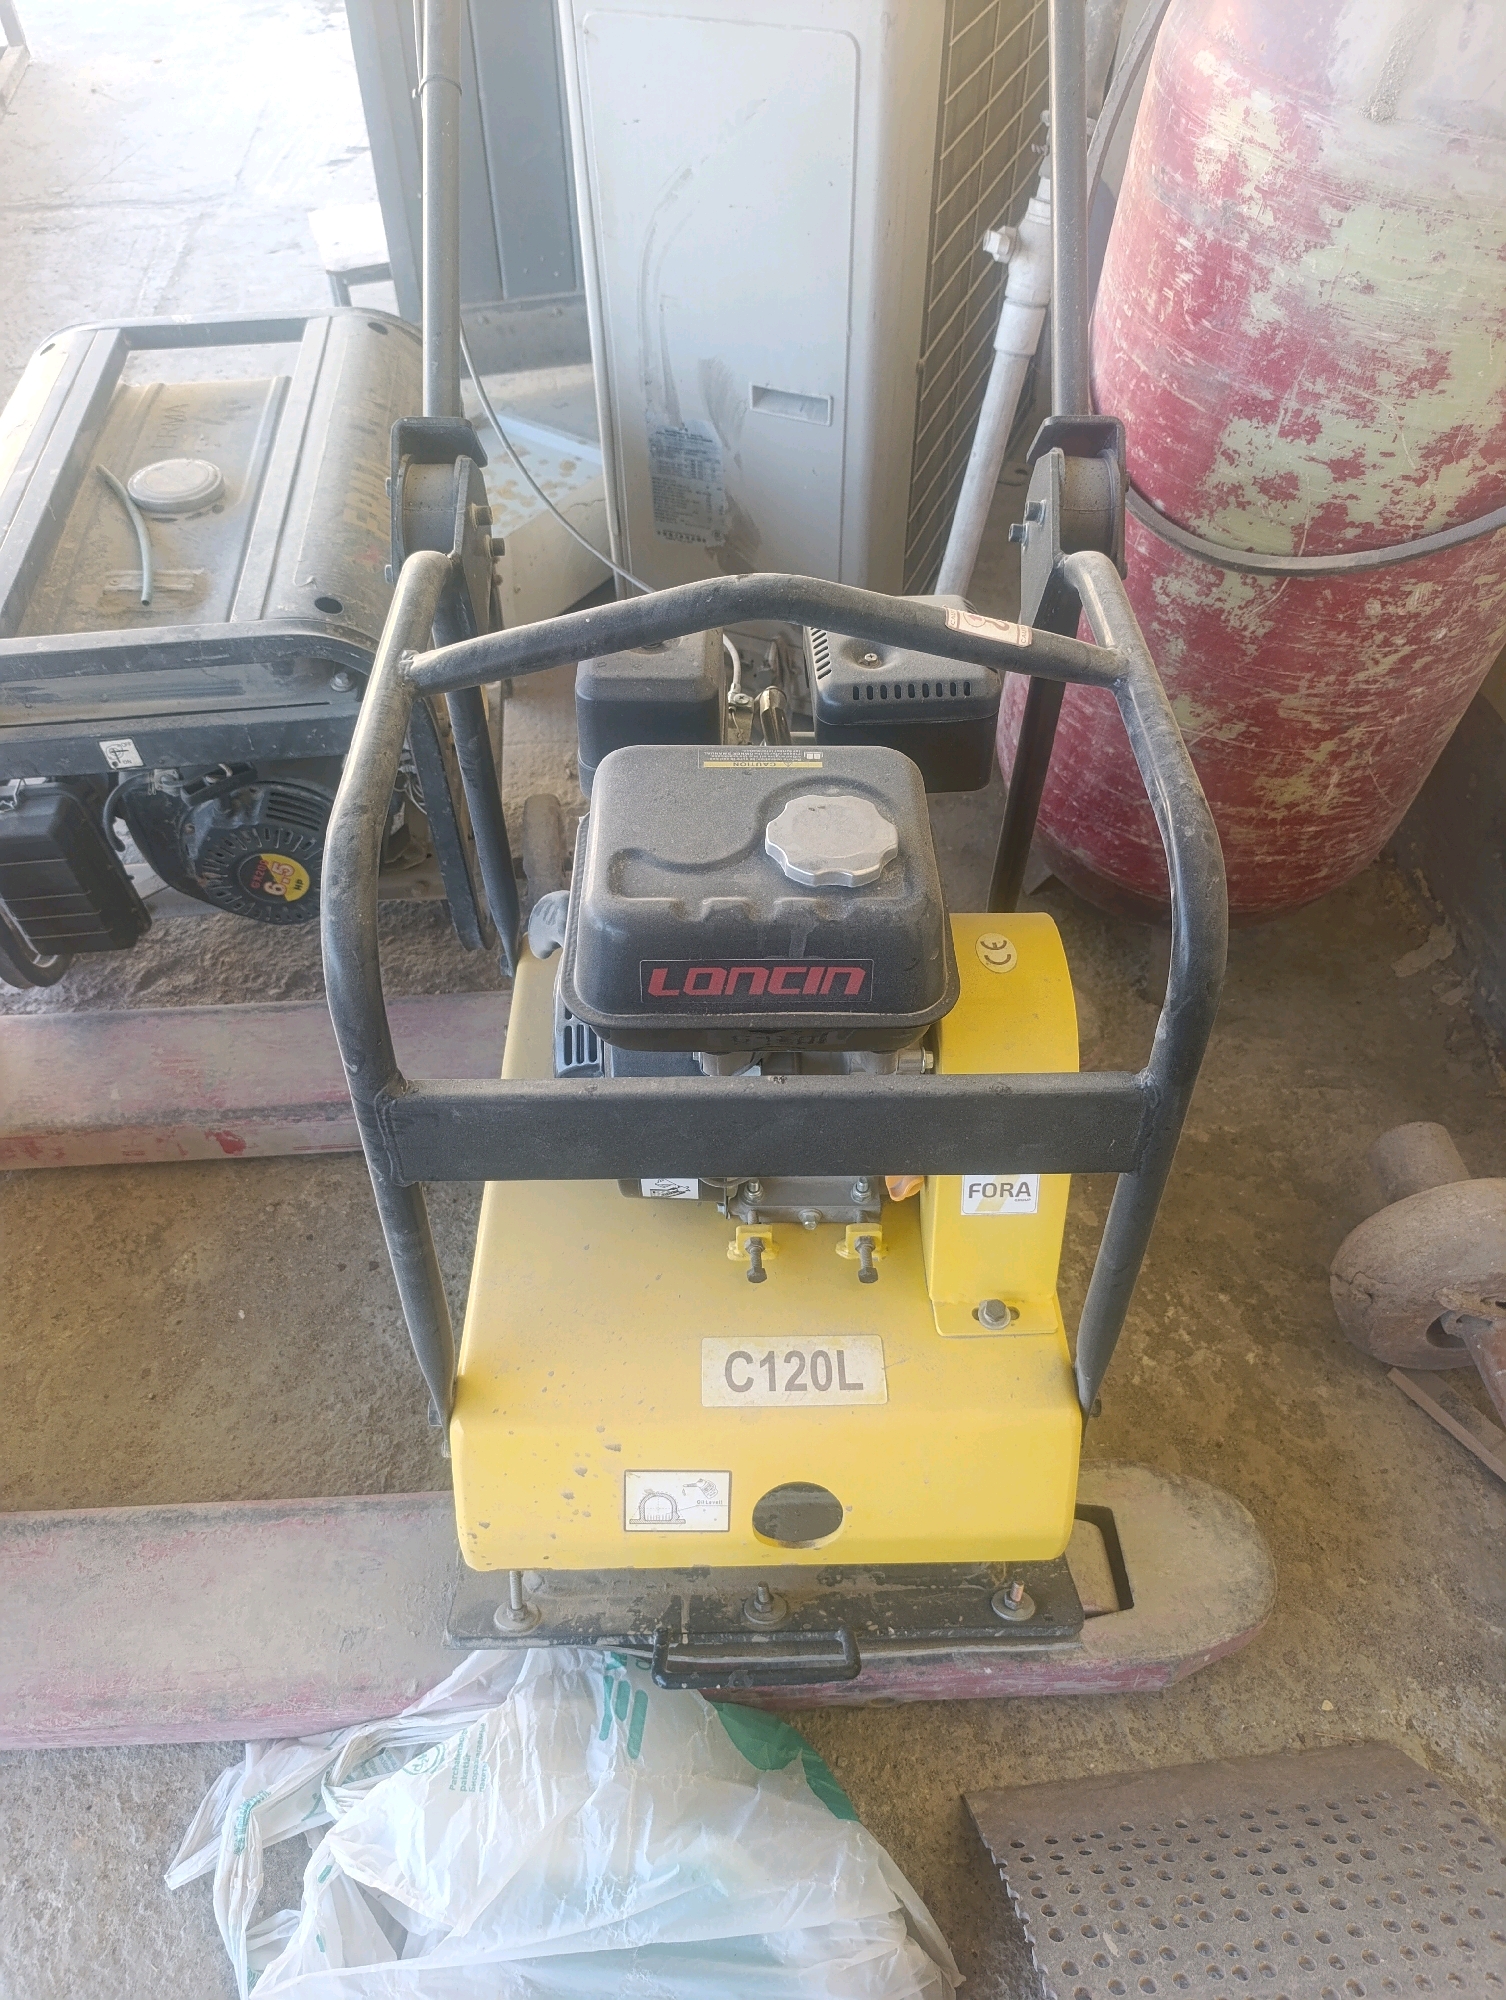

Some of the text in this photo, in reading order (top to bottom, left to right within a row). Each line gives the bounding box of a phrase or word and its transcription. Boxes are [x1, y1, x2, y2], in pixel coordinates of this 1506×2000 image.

[263, 861, 295, 896] 6.5
[968, 1181, 1031, 1199] FORA
[724, 1349, 864, 1393] C120L
